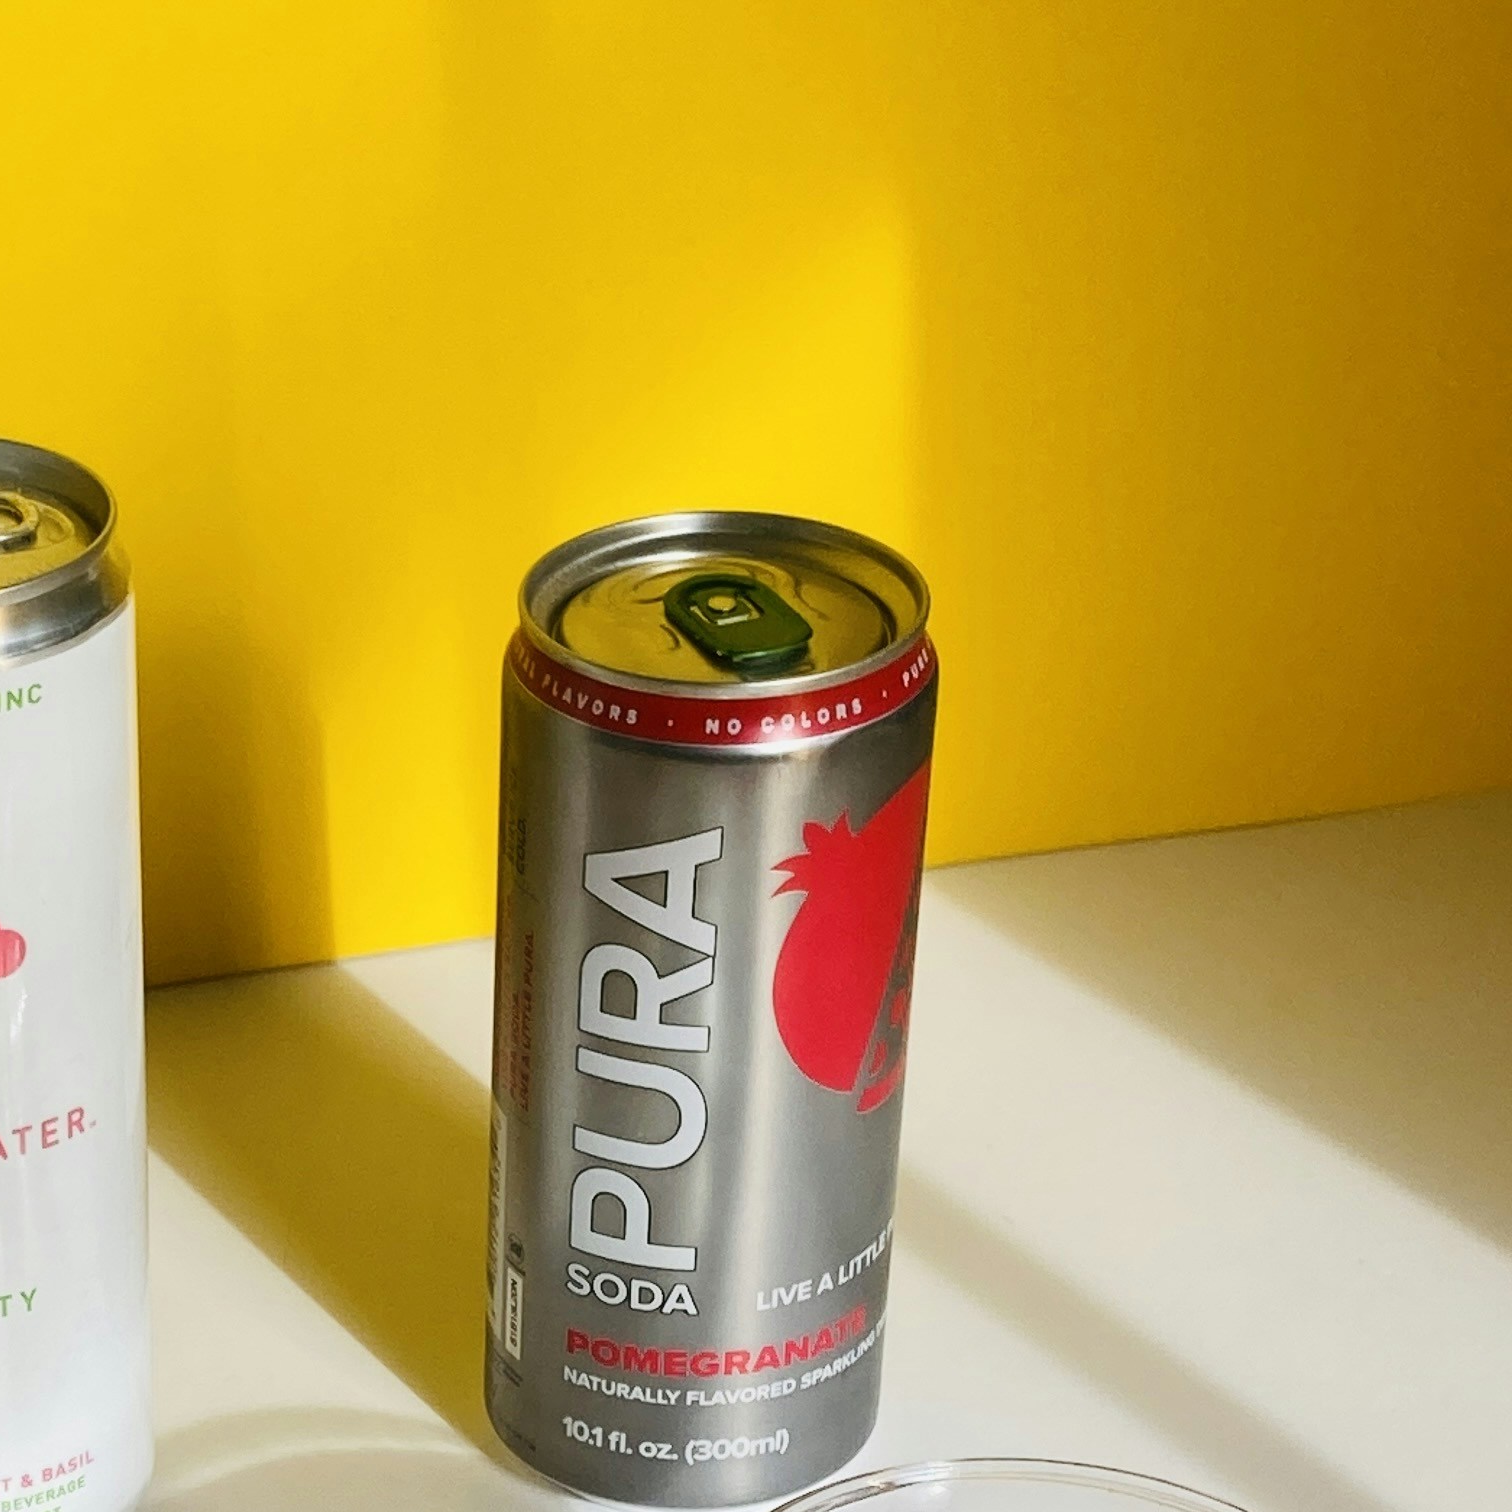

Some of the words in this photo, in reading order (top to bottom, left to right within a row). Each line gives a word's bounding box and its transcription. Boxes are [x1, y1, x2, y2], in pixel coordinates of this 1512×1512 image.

[542, 673, 638, 725] FLAVORS
[705, 718, 742, 735] NO
[761, 698, 862, 735] COLORS
[569, 826, 724, 1271] PURA
[566, 1262, 700, 1317] SODA
[756, 1279, 813, 1311] LIVE
[817, 1272, 834, 1295] A
[838, 1230, 887, 1285] LITTLE
[563, 1365, 681, 1405] NATURALLY
[686, 1377, 797, 1406] FLAVORED
[799, 1330, 875, 1390] SPARKLING
[566, 1302, 867, 1378] POMEGRANATE
[21, 1473, 34, 1488] &
[42, 1450, 95, 1483] BASIL
[563, 1416, 604, 1448] 10.1
[608, 1430, 633, 1454] fl.
[638, 1440, 678, 1460] oz.
[685, 1428, 790, 1466] (300ml)
[1, 1475, 86, 1512] BEVERAGE
